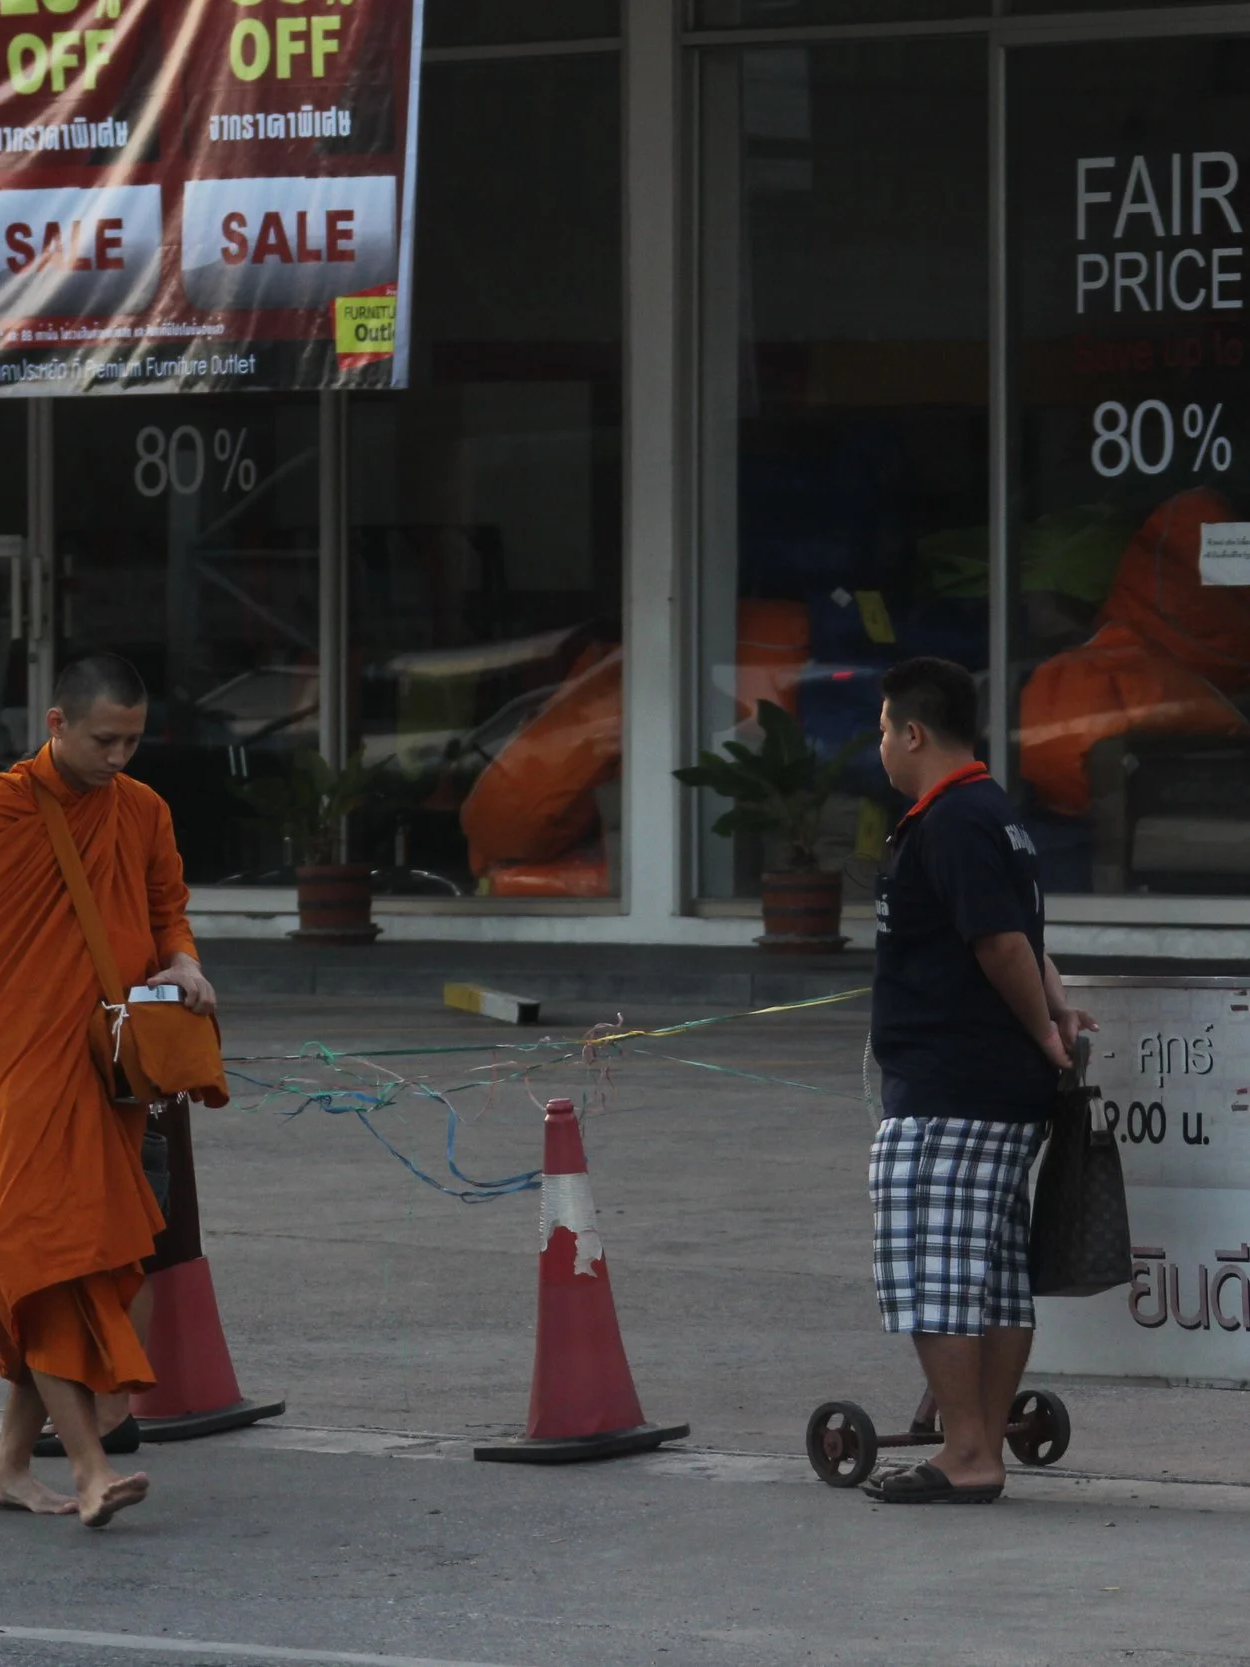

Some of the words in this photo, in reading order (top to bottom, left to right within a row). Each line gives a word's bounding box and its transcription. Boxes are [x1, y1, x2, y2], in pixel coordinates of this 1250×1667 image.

[7, 28, 115, 95] OFF
[230, 15, 341, 81] OFF
[209, 105, 352, 142] จากราคาพิเศษ
[1077, 151, 1243, 240] FAIR
[4, 217, 124, 275] SALE
[220, 209, 356, 266] SALE
[1077, 248, 1243, 314] PRICE
[355, 322, 396, 342] Outl
[1073, 333, 1153, 373] Save
[1163, 337, 1203, 378] up
[1212, 329, 1245, 367] to
[84, 357, 141, 379] Premium
[146, 356, 206, 377] Furniture
[211, 353, 256, 375] Outlet
[132, 425, 257, 497] 80%
[1090, 399, 1233, 477] 80%
[1138, 1023, 1214, 1088] ศุกร์
[1182, 1112, 1209, 1145] น.
